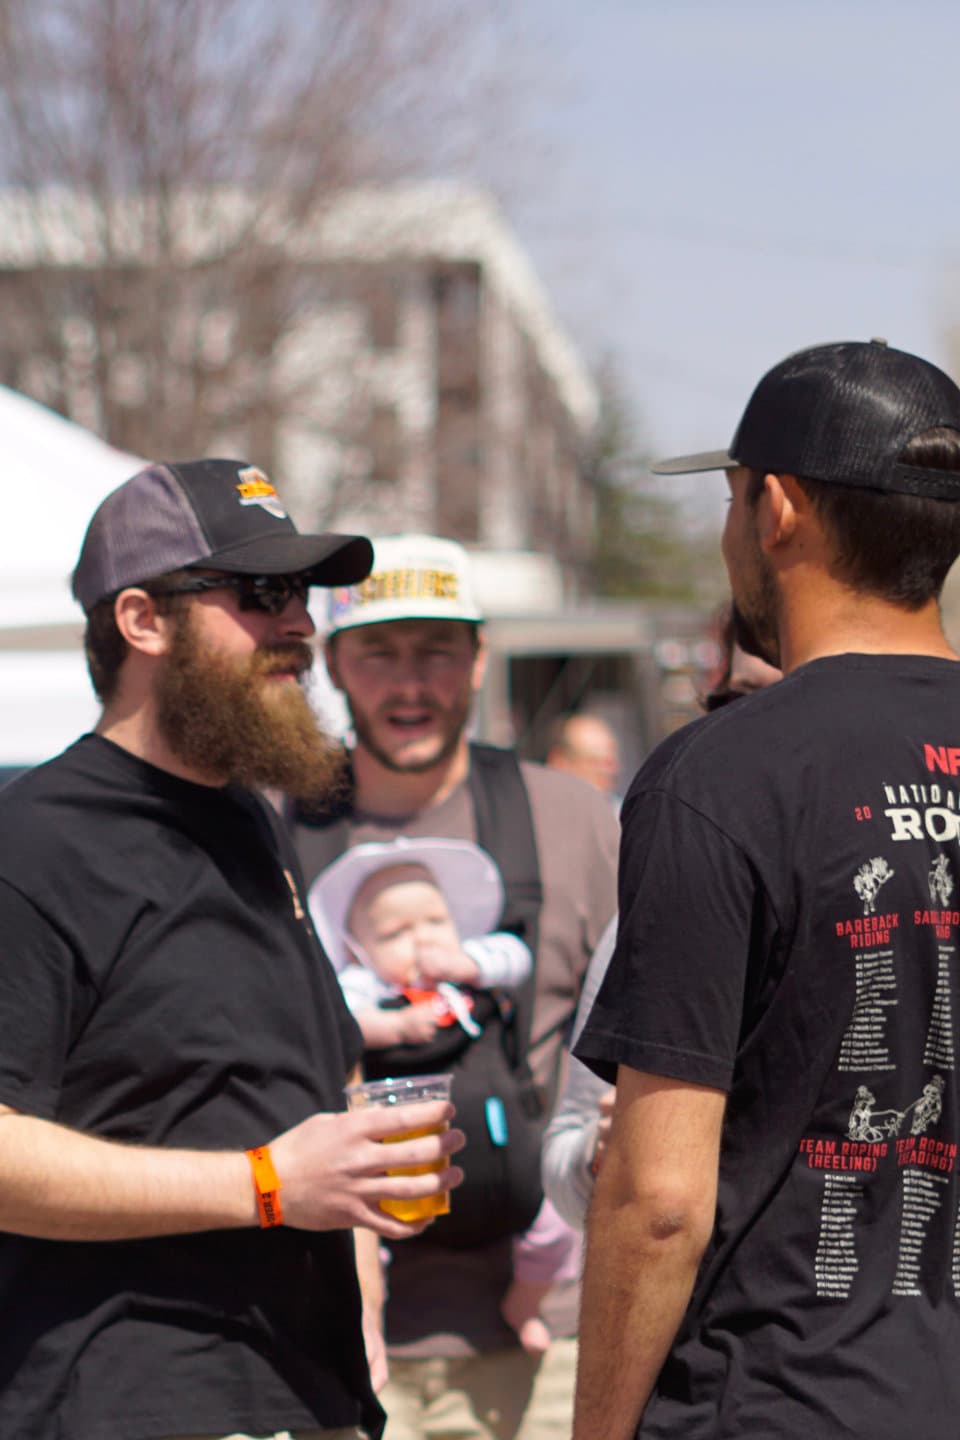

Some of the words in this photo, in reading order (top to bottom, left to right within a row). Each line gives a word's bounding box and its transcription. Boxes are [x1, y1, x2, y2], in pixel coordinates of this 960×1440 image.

[855, 806, 872, 821] 20
[836, 913, 899, 936] BAREBACK
[850, 930, 890, 948] RIDING
[799, 1139, 836, 1154] TEAM
[841, 1141, 888, 1158] ROPING
[808, 1154, 878, 1174] (HEELING)
